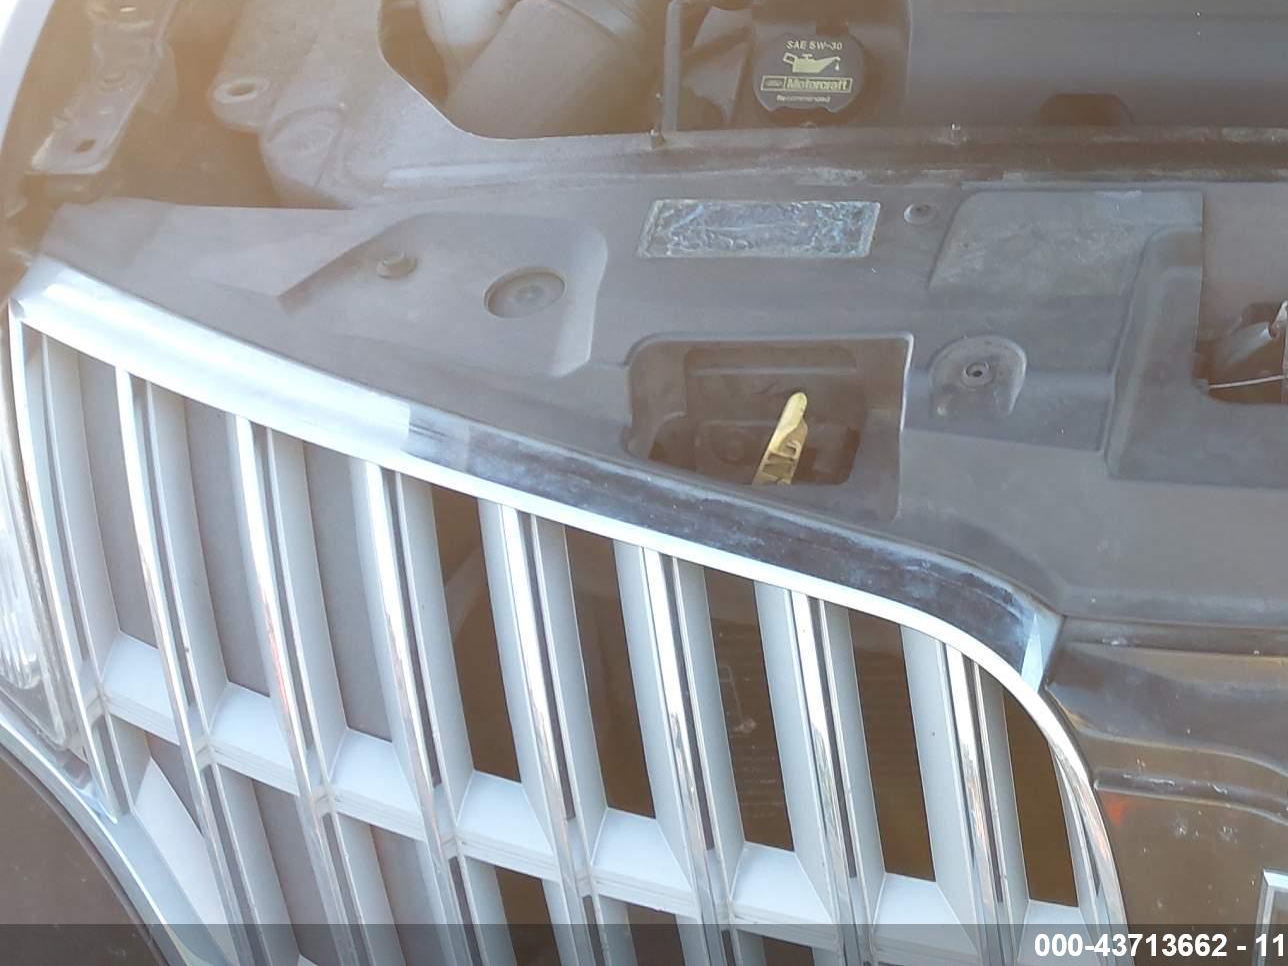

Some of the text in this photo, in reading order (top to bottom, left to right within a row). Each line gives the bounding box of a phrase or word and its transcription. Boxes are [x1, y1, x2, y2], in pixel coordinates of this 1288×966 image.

[786, 40, 843, 50] SAE 5W-30
[787, 78, 848, 90] Motorcraft
